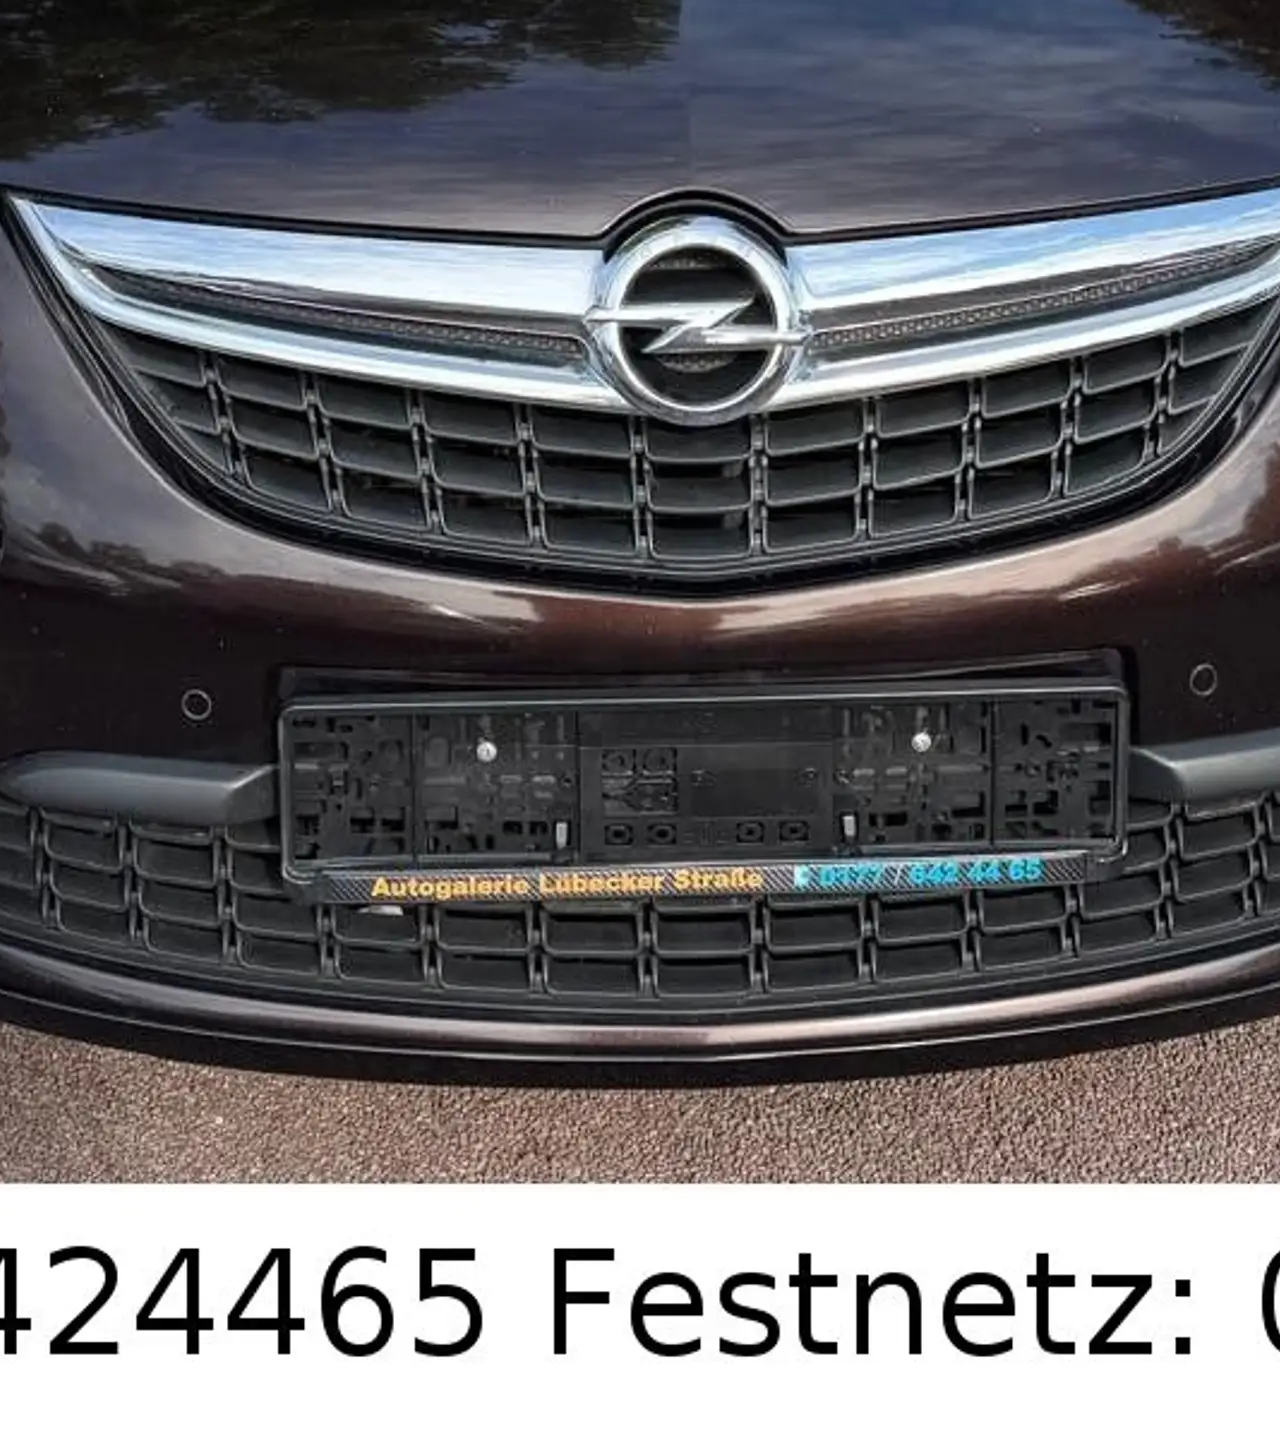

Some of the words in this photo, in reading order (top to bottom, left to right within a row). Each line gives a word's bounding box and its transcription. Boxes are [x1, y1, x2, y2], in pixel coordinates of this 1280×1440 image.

[370, 873, 529, 901] Autogalerie
[672, 865, 764, 891] Straße
[909, 860, 960, 884] 642
[1008, 858, 1042, 881] 65
